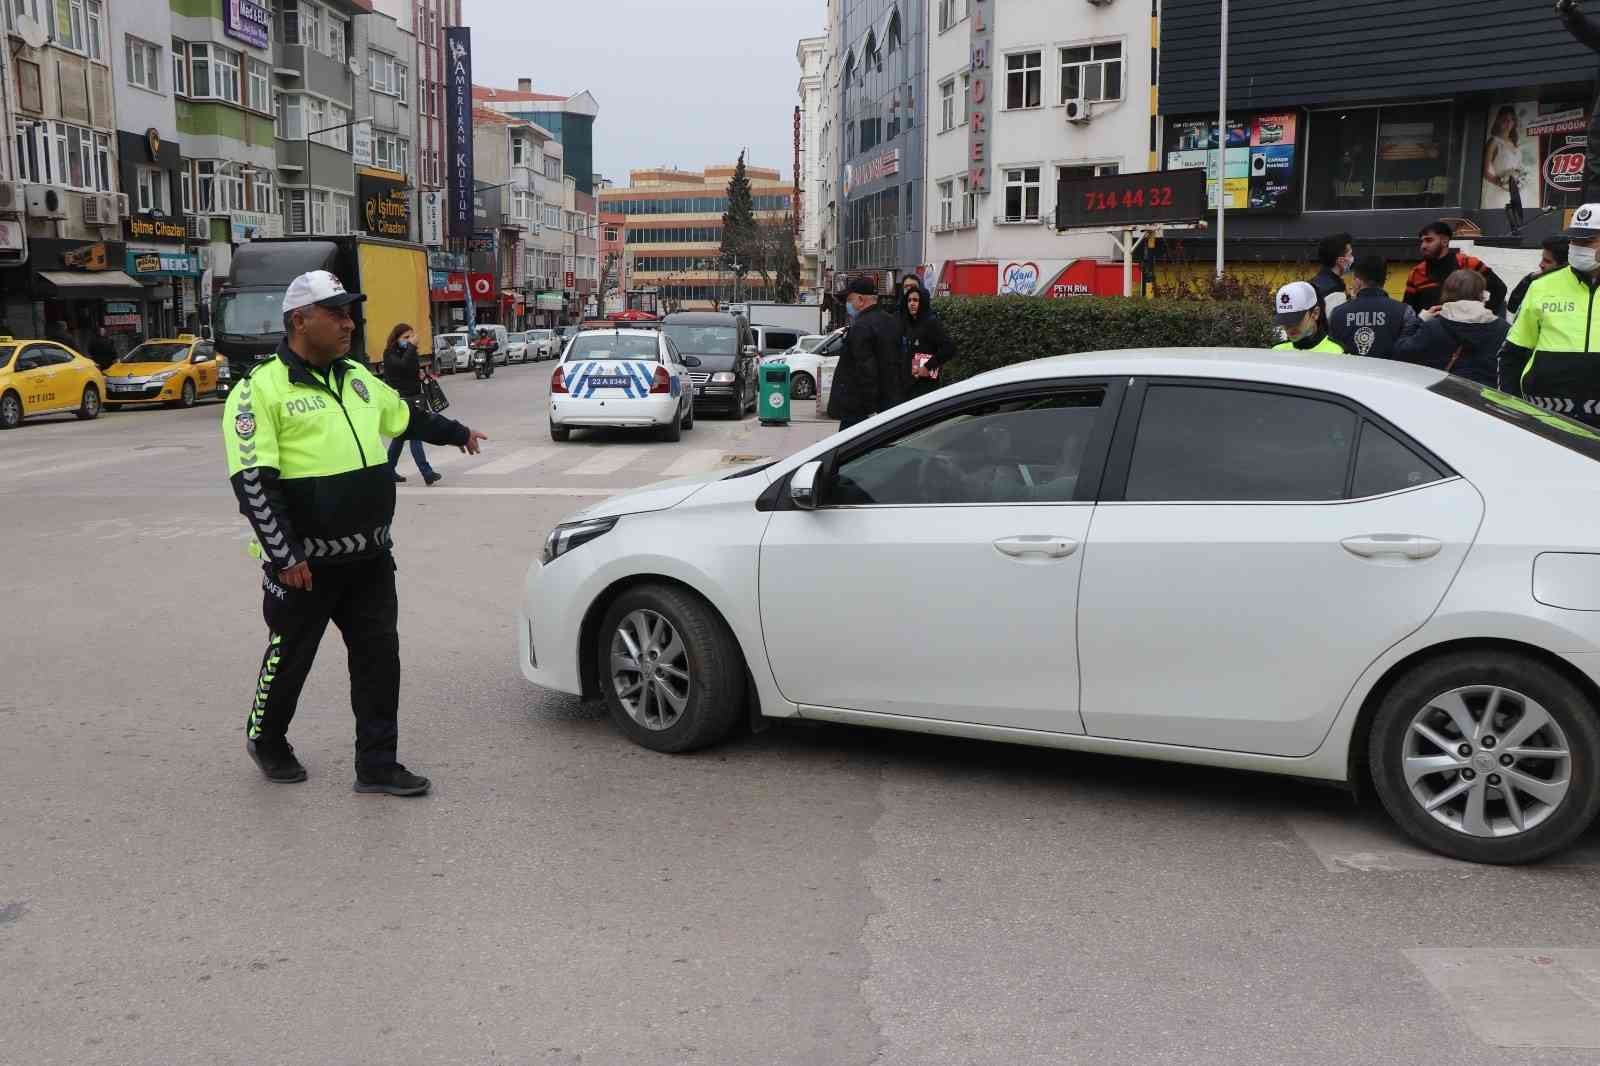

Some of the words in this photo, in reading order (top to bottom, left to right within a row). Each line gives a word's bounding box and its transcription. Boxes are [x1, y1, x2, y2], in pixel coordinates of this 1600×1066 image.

[1086, 191, 1117, 210] 714
[1121, 189, 1145, 208] 44
[1149, 186, 1172, 206] 32
[468, 239, 493, 249] KPSS
[1542, 302, 1575, 312] POLİS
[286, 395, 327, 416] POLİS
